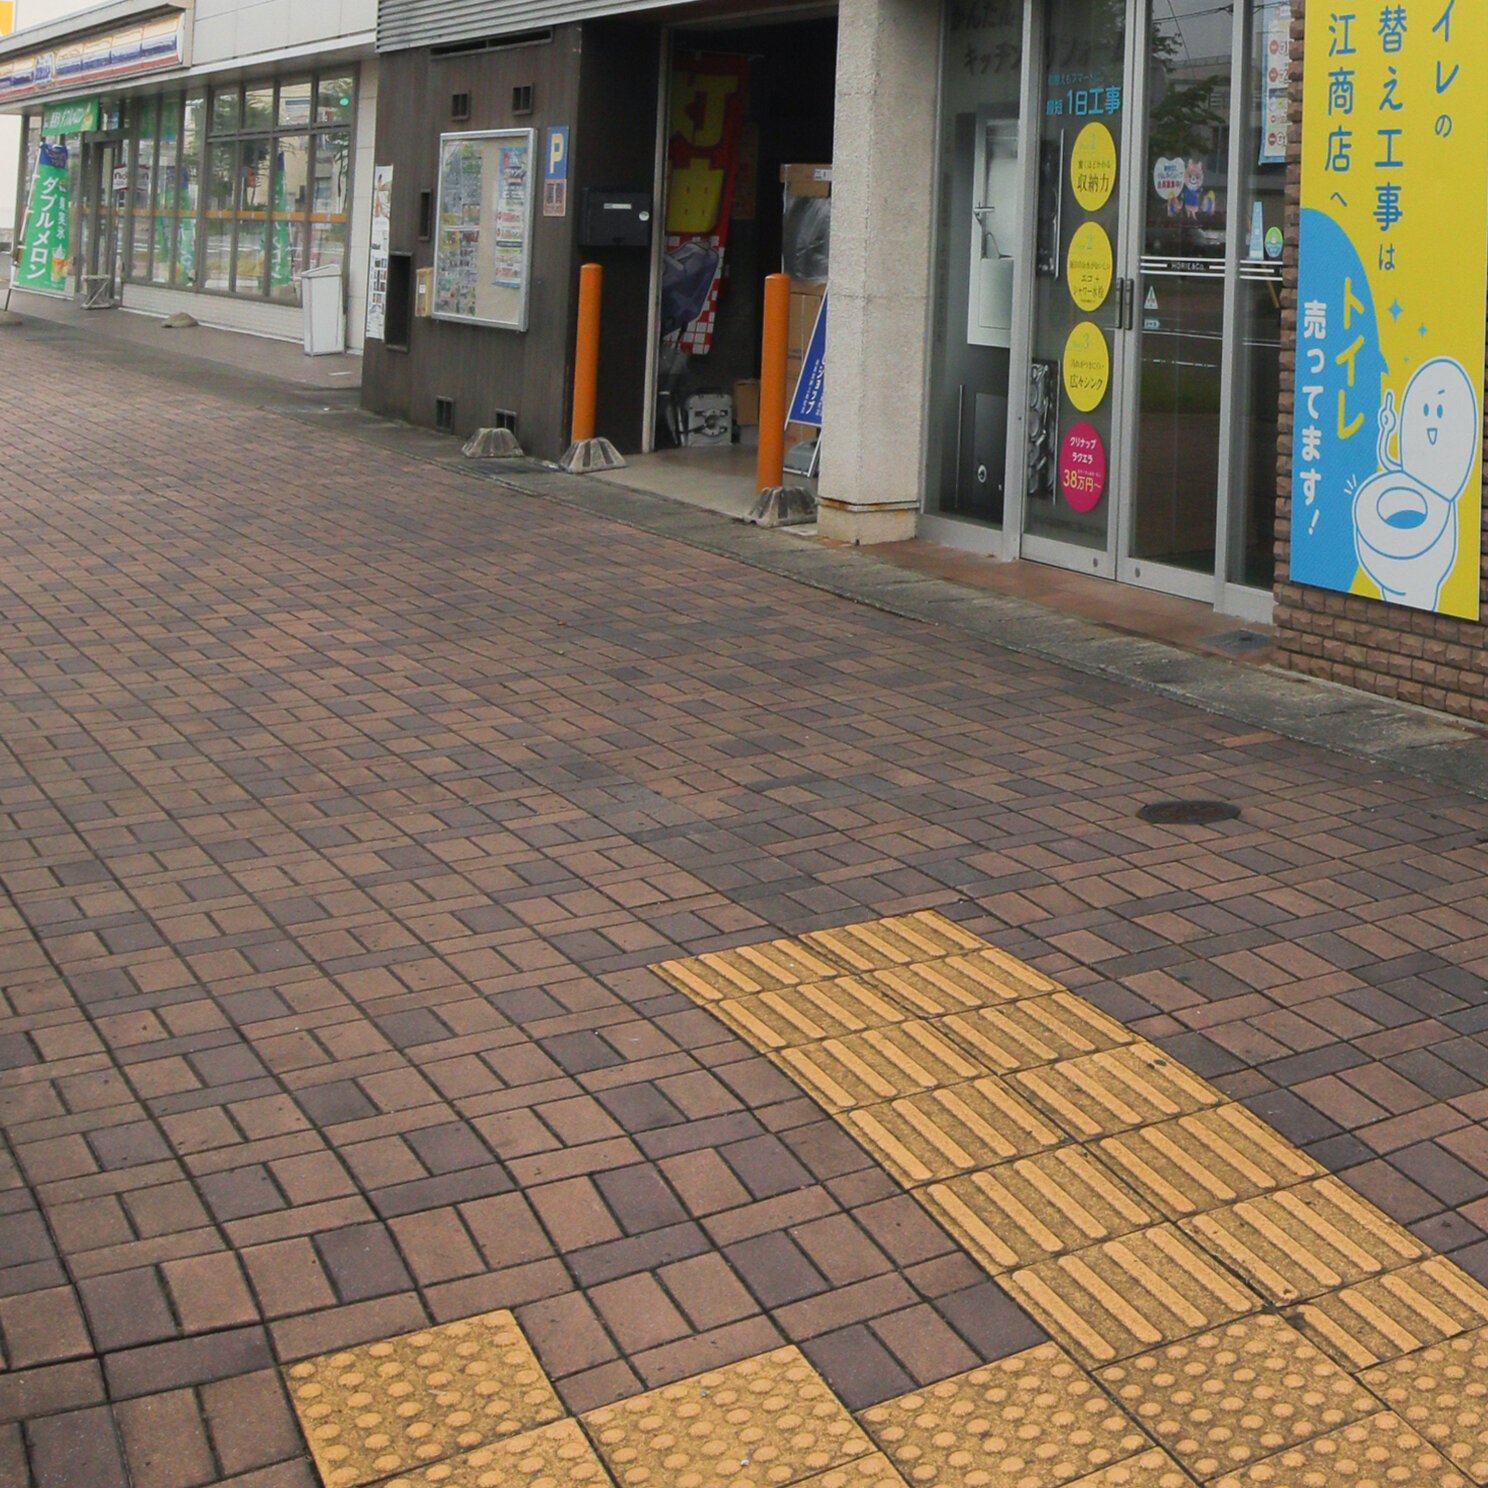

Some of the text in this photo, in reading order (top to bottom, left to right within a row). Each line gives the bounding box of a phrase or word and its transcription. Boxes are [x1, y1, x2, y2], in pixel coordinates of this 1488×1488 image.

[1067, 85, 1121, 116] 1日工事
[550, 133, 564, 173] P
[1077, 172, 1110, 193] 収納力
[27, 176, 59, 280] ダブルメロン
[1336, 277, 1365, 440] トイレ
[1300, 300, 1327, 535] 売ってます!
